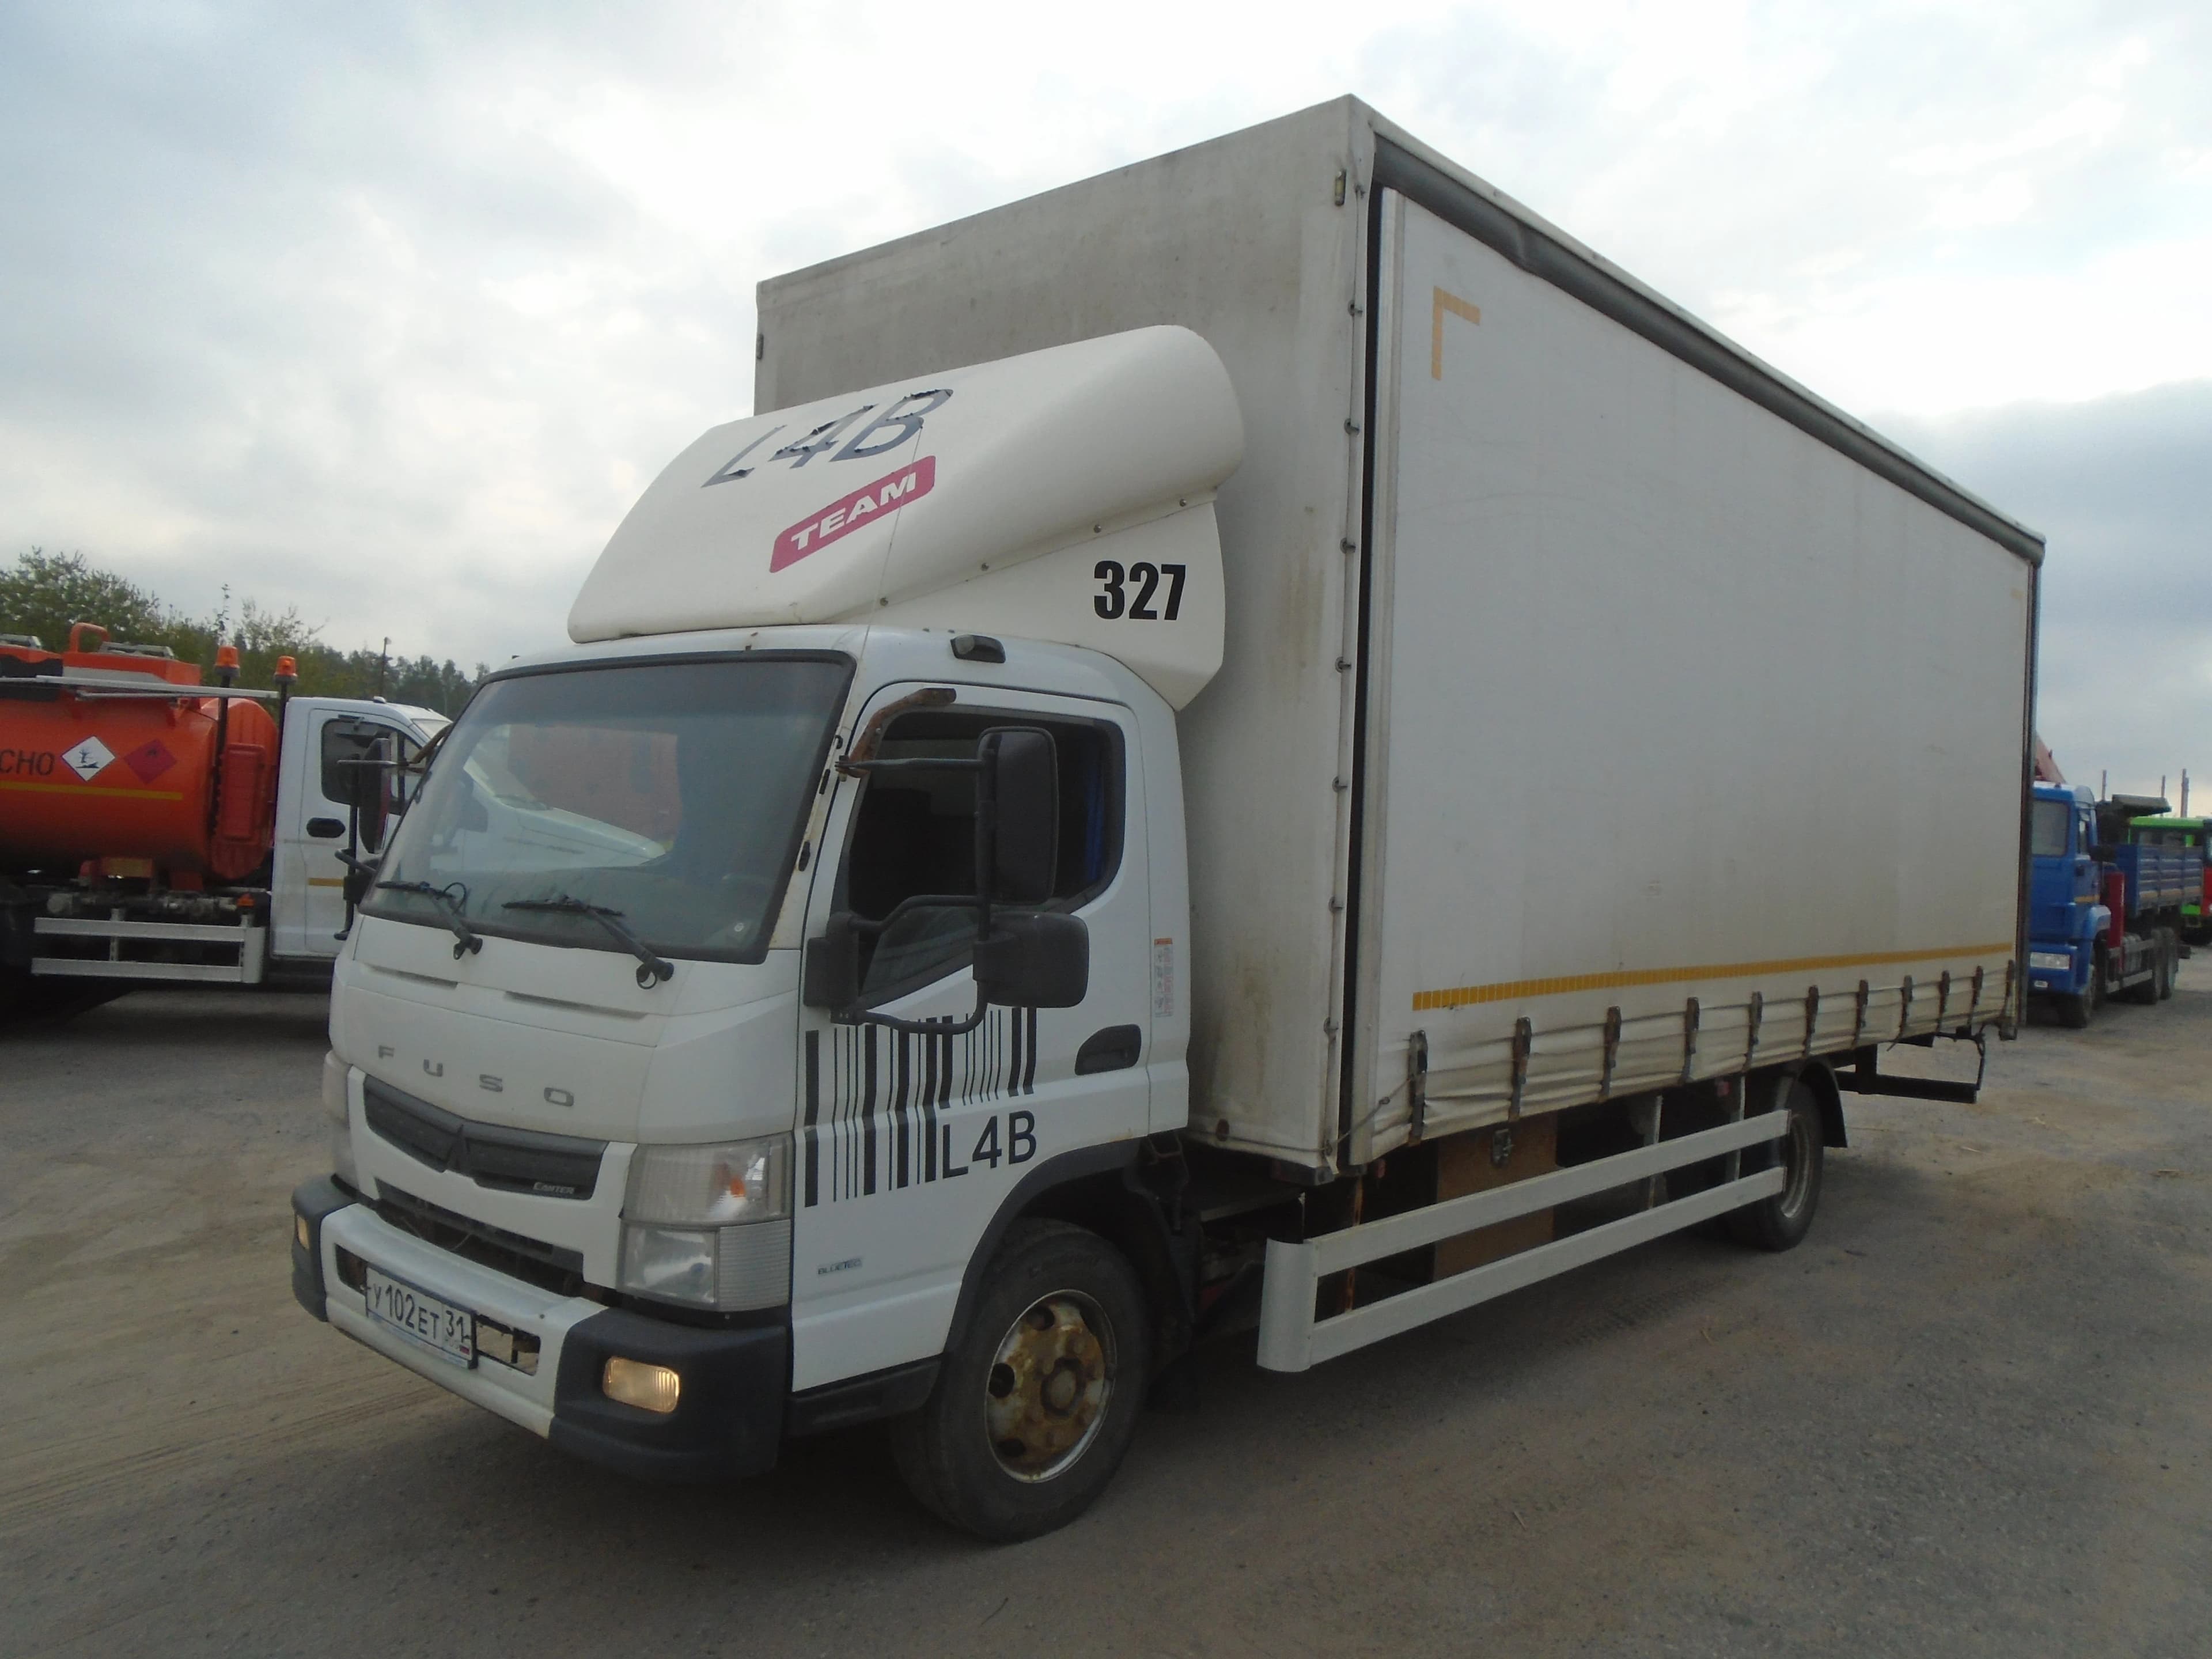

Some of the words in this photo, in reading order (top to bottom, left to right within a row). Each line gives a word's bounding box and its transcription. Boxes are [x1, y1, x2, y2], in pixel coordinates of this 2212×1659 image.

[700, 388, 954, 488] L4B
[791, 472, 917, 551] TEAM
[1094, 560, 1186, 620] 327
[378, 1045, 574, 1107] FUSO
[942, 1110, 1037, 1179] L4B
[445, 1309, 464, 1344] 31
